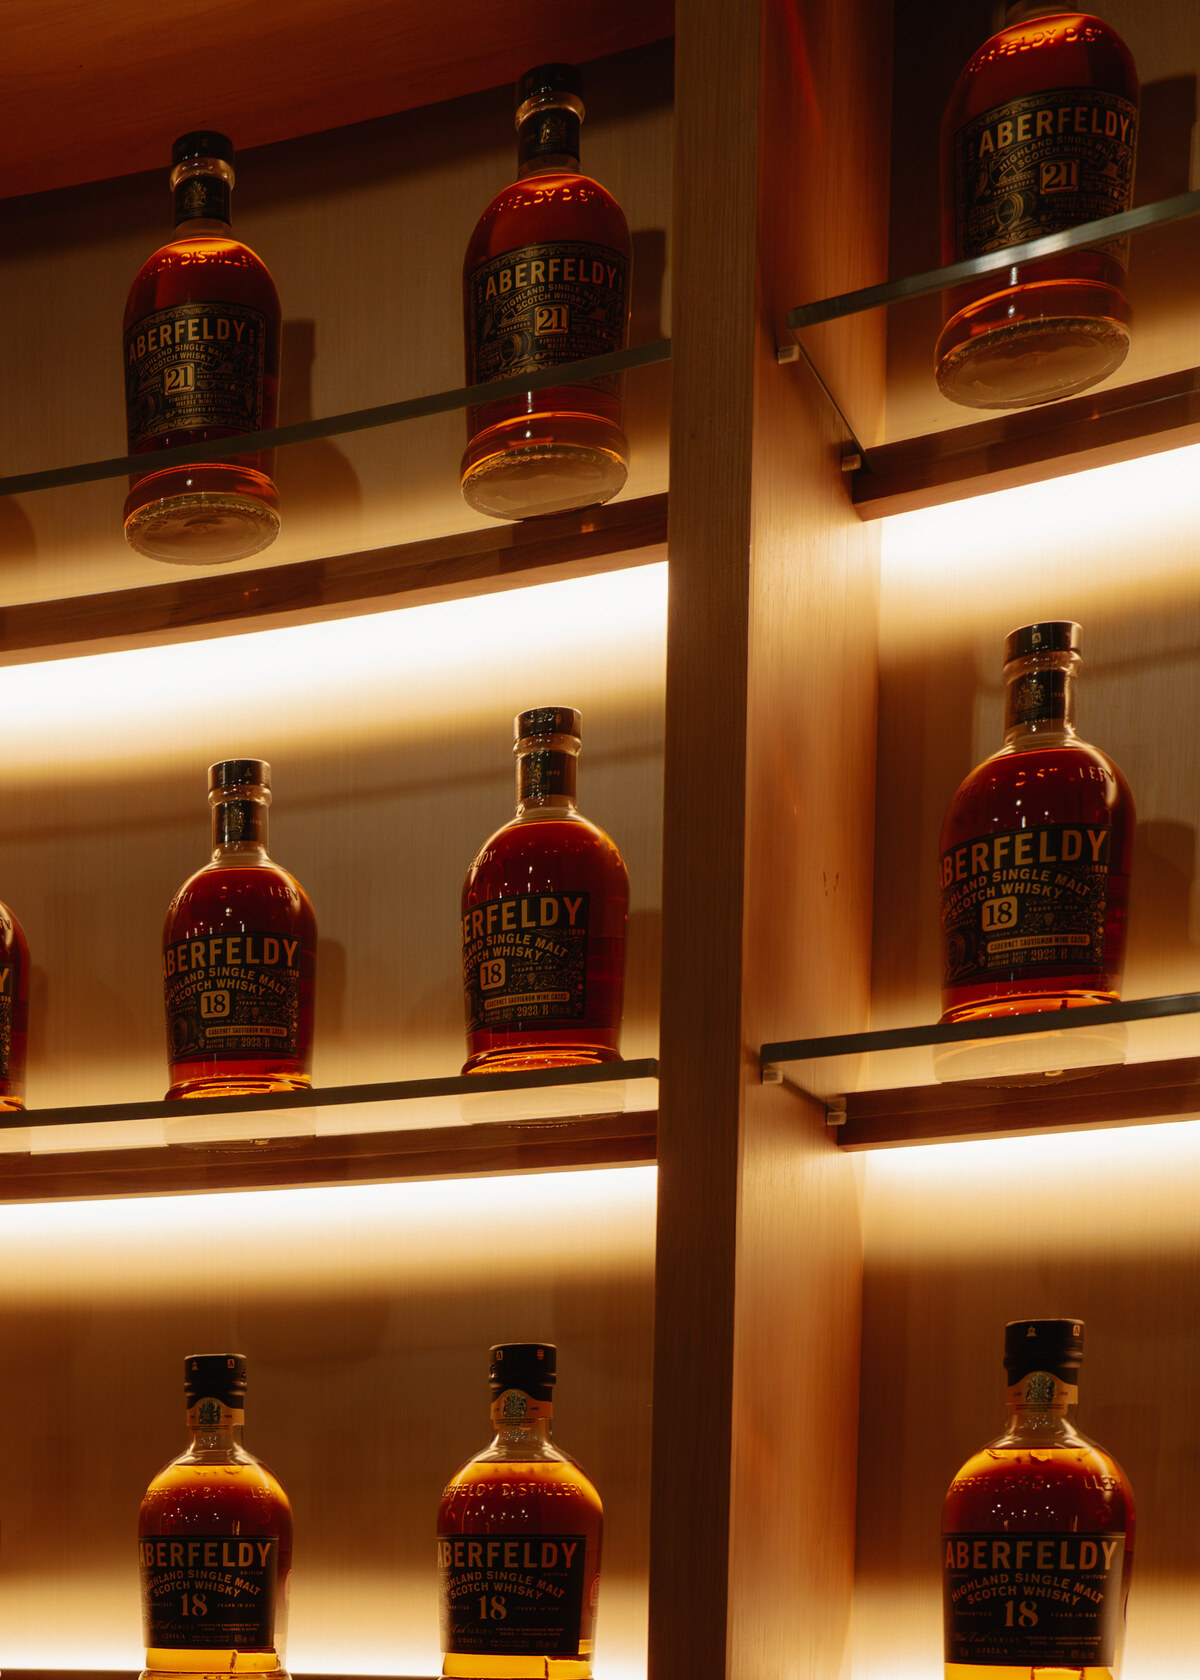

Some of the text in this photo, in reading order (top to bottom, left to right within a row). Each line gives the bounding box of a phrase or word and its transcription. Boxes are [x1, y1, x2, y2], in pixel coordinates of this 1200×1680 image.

[978, 106, 1130, 158] ABERFELDY
[999, 137, 1052, 172] HIGHLAND
[1018, 146, 1060, 168] SCOTCH
[1044, 163, 1073, 190] 21
[485, 258, 616, 299] ABERFELDY
[501, 285, 544, 314] HIGHLAND
[516, 293, 550, 311] SCOTCH
[538, 308, 565, 330] 21
[128, 317, 245, 367] ABERFELDY
[175, 343, 205, 352] SINGLE
[180, 352, 212, 361] WHISKY
[167, 368, 191, 391] 21
[992, 869, 1090, 896] SINGLE MALT
[1000, 882, 1063, 900] WHISKY
[986, 901, 1012, 927] 18
[487, 933, 568, 957] SINGLE MALT
[492, 946, 542, 961] WHISKY
[209, 967, 286, 995] SINGLE MALT
[216, 979, 264, 995] WHISKY
[483, 964, 501, 986] 18
[204, 995, 225, 1014] 18
[945, 1541, 1117, 1570] ABERFELDY
[153, 1581, 240, 1598] SCOTCH WHISKY
[188, 1570, 260, 1595] SINGLE MALT
[450, 1581, 543, 1600] SCOTCH WHISKY
[486, 1571, 565, 1599] SINGLE MALT
[952, 1573, 1104, 1604] HIGHLAND SINGLE MALT
[180, 1593, 208, 1616] 18
[478, 1595, 507, 1620] 18
[966, 1586, 1082, 1606] SCOTCH WHISKY
[1003, 1600, 1039, 1627] 18
